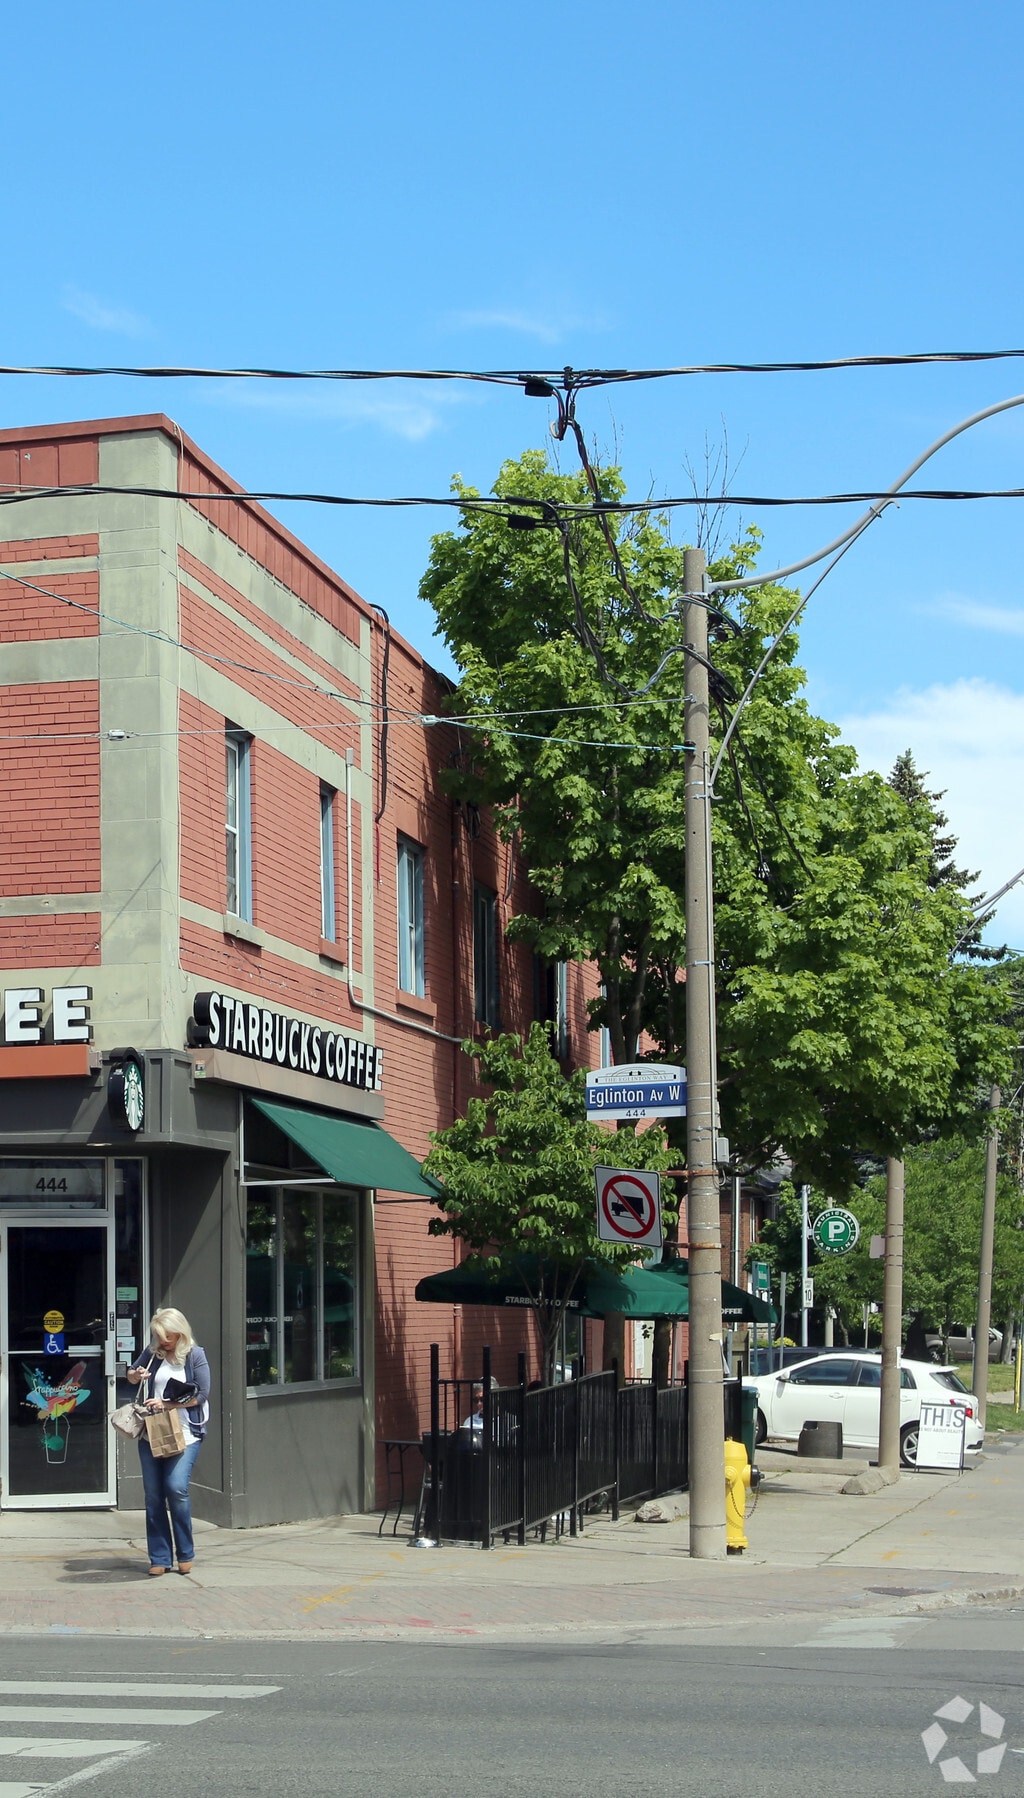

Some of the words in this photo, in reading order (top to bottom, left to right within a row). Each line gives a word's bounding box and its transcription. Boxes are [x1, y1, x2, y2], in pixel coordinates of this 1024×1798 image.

[208, 991, 322, 1074] STARBUCKS
[326, 1030, 384, 1091] COFFEE
[589, 1088, 644, 1107] Eglinton
[650, 1089, 663, 1101] Av
[669, 1086, 680, 1100] W
[625, 1109, 646, 1117] 444
[36, 1177, 68, 1193] 444
[828, 1221, 845, 1239] P
[805, 1289, 812, 1302] 10
